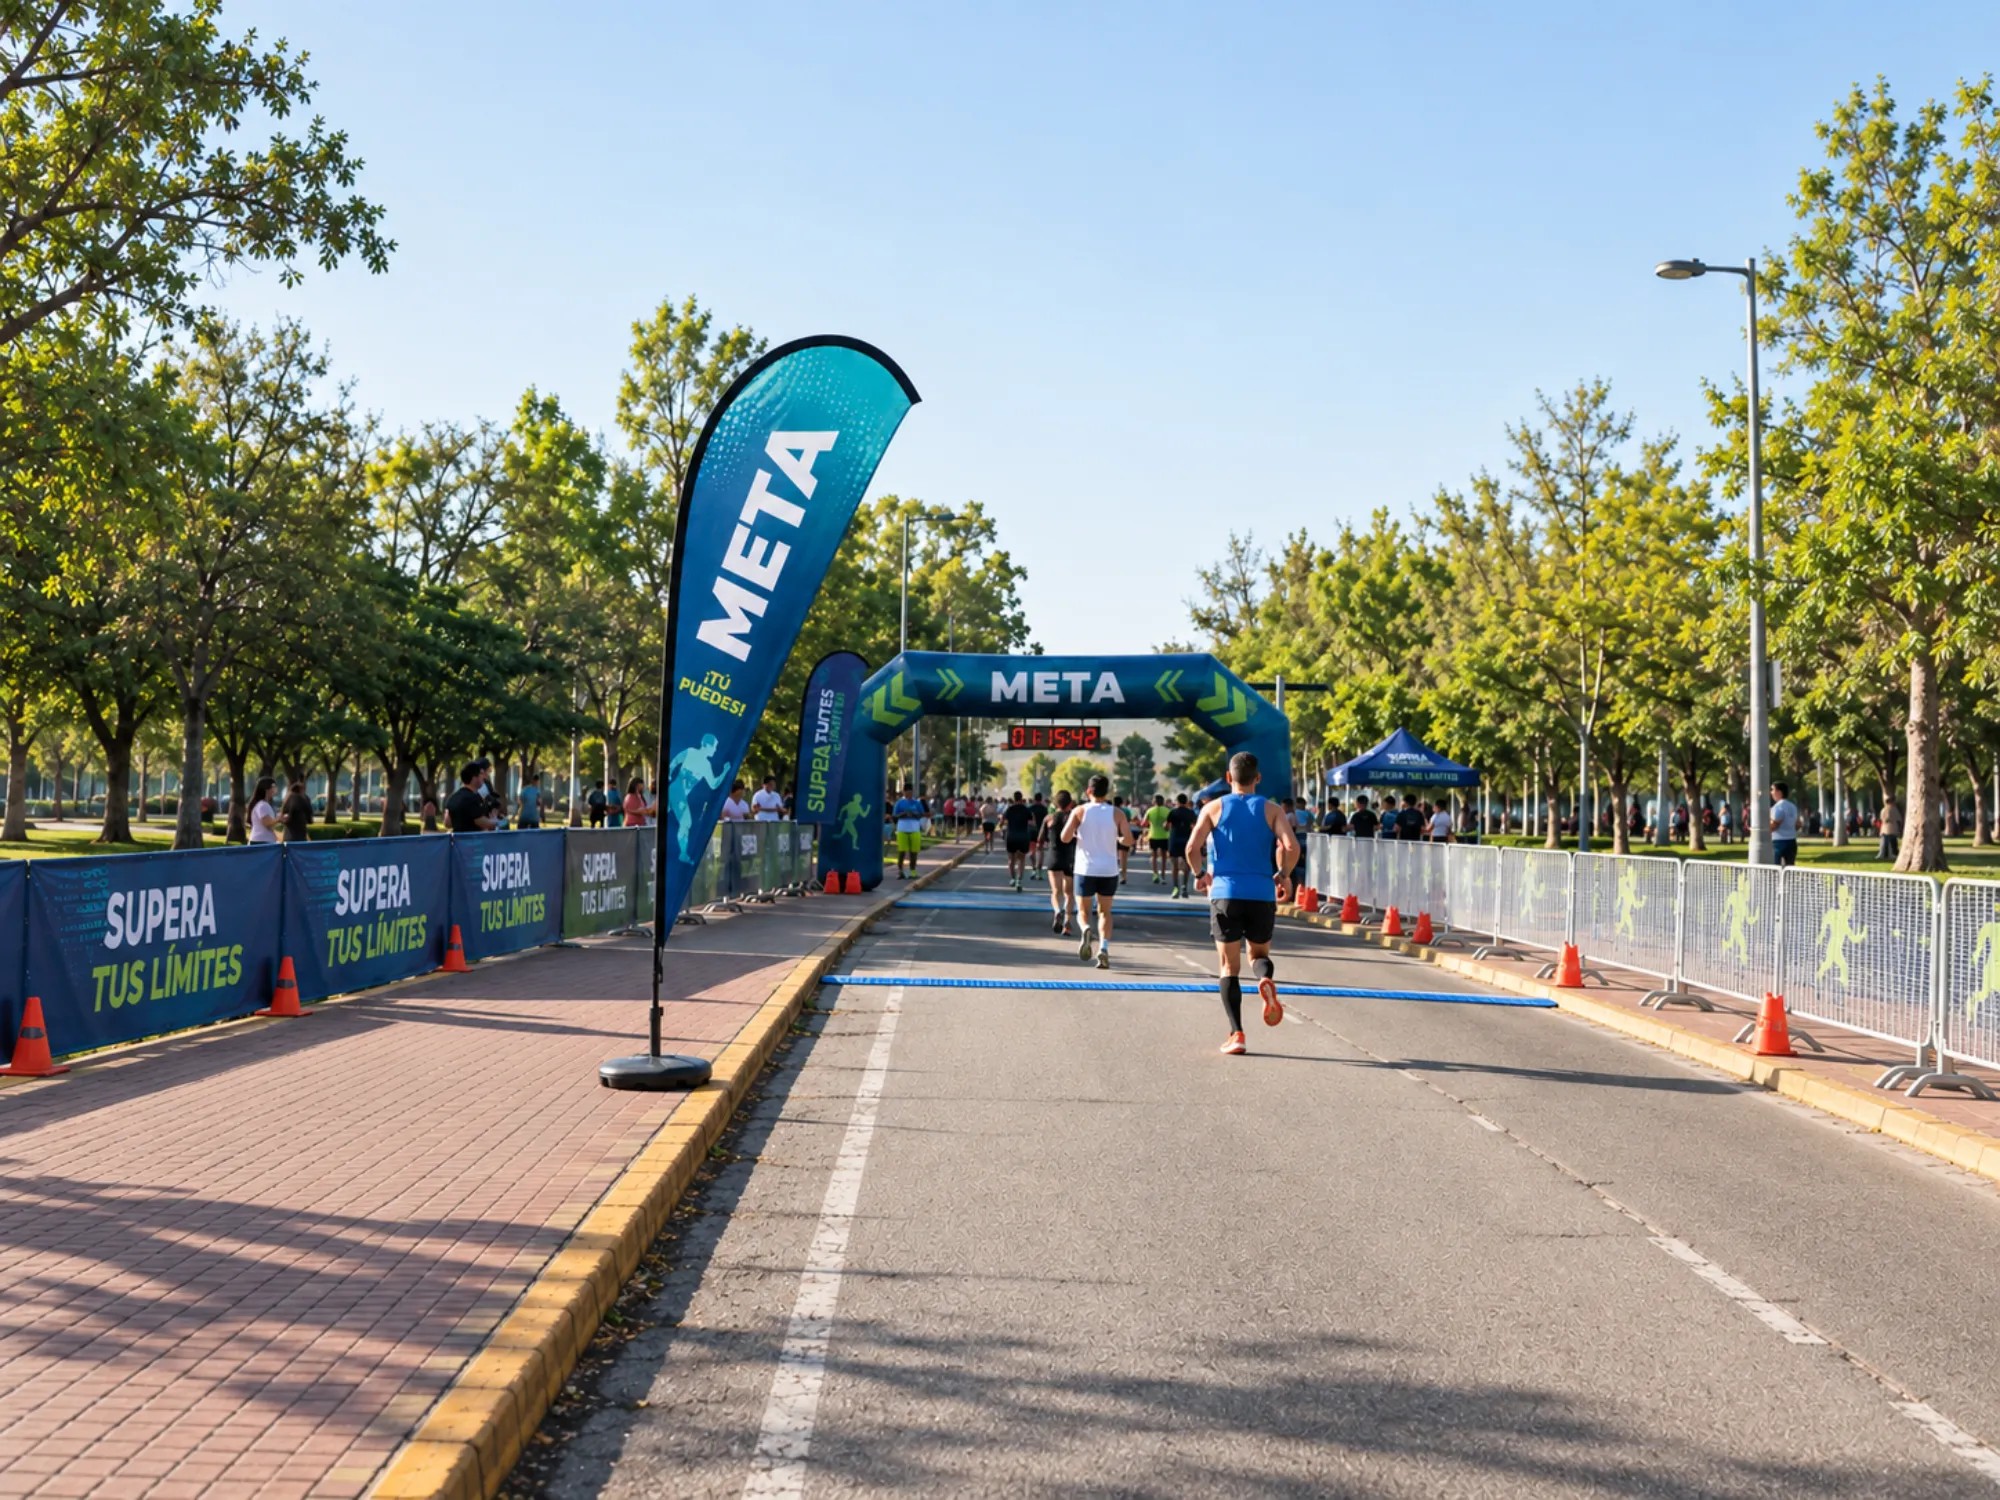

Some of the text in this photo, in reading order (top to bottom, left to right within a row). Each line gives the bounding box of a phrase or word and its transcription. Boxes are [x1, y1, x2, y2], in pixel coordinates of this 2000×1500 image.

[696, 430, 839, 663] META
[679, 676, 747, 717] PUEDES!
[703, 670, 731, 691] ¡TÚ
[991, 671, 1126, 703] META
[335, 863, 411, 917] SUPERA
[482, 851, 531, 892] SUPERA
[103, 883, 217, 950] SUPERA
[480, 899, 503, 933] TUS
[581, 890, 597, 916] TUS
[327, 925, 363, 968] TUS
[92, 960, 146, 1013] TUS
